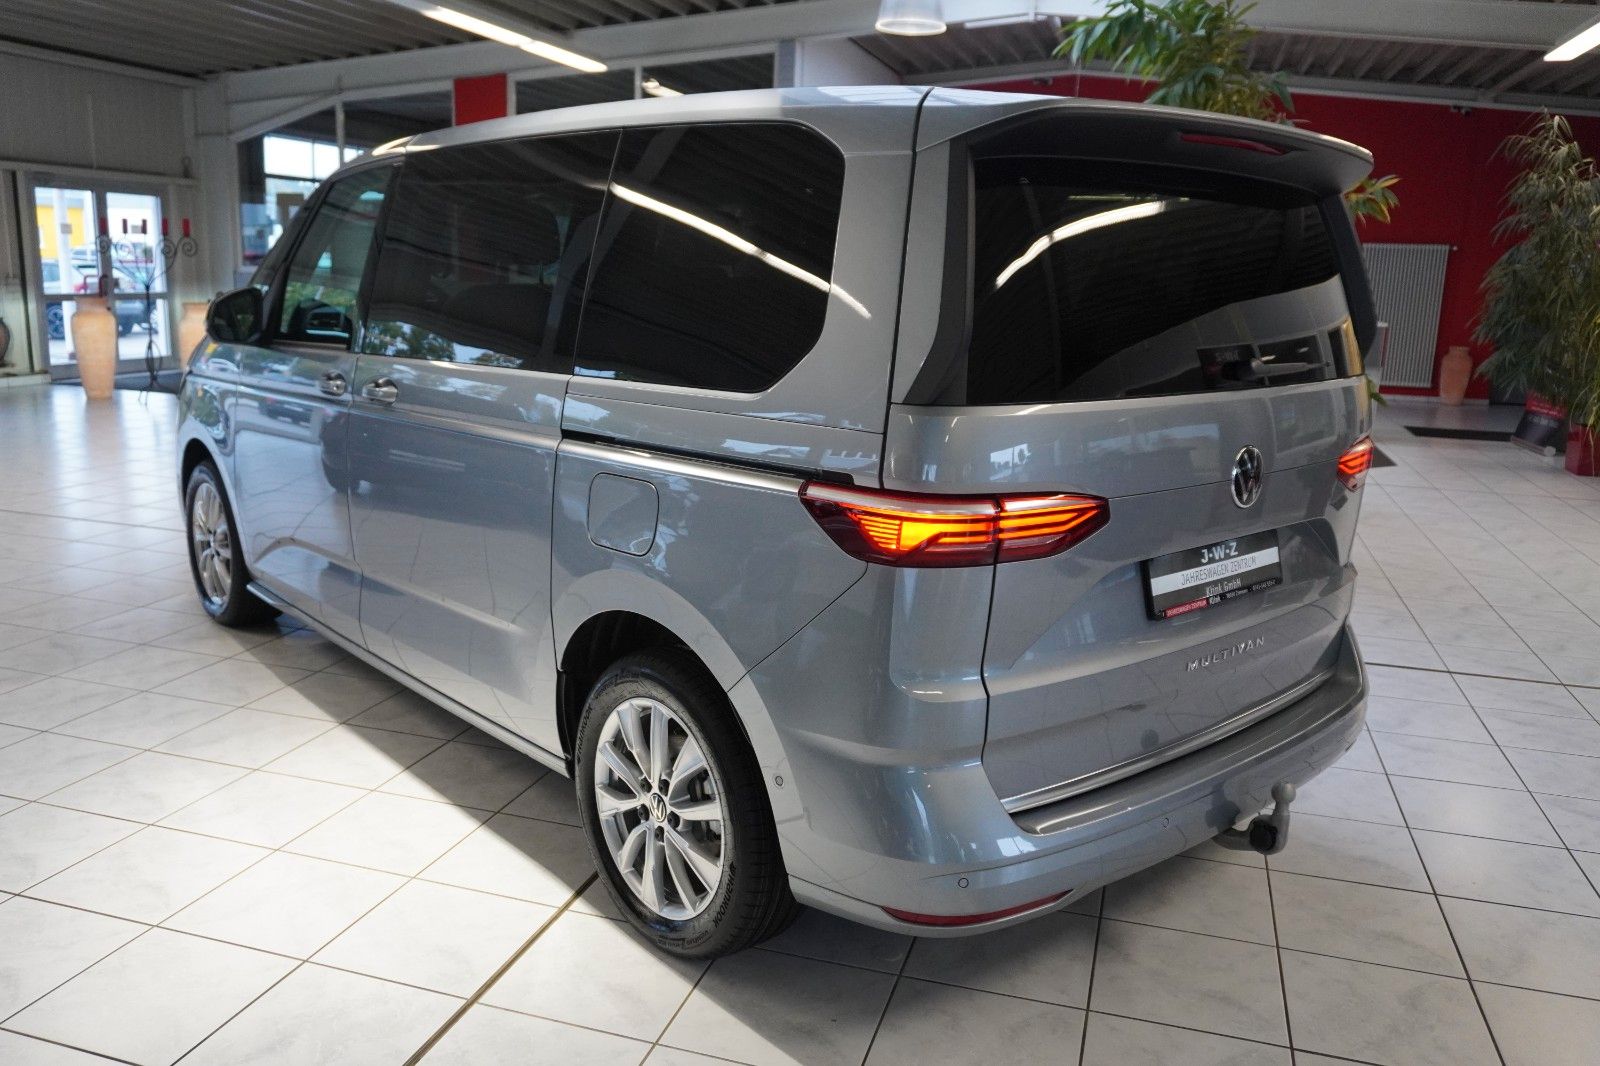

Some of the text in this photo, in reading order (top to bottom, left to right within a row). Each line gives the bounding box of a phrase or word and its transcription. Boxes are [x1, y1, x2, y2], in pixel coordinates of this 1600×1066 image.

[1181, 563, 1229, 585] JAHRESWAGEN
[1230, 555, 1257, 573] ZENTRUM
[1187, 636, 1265, 672] MULTIVAN
